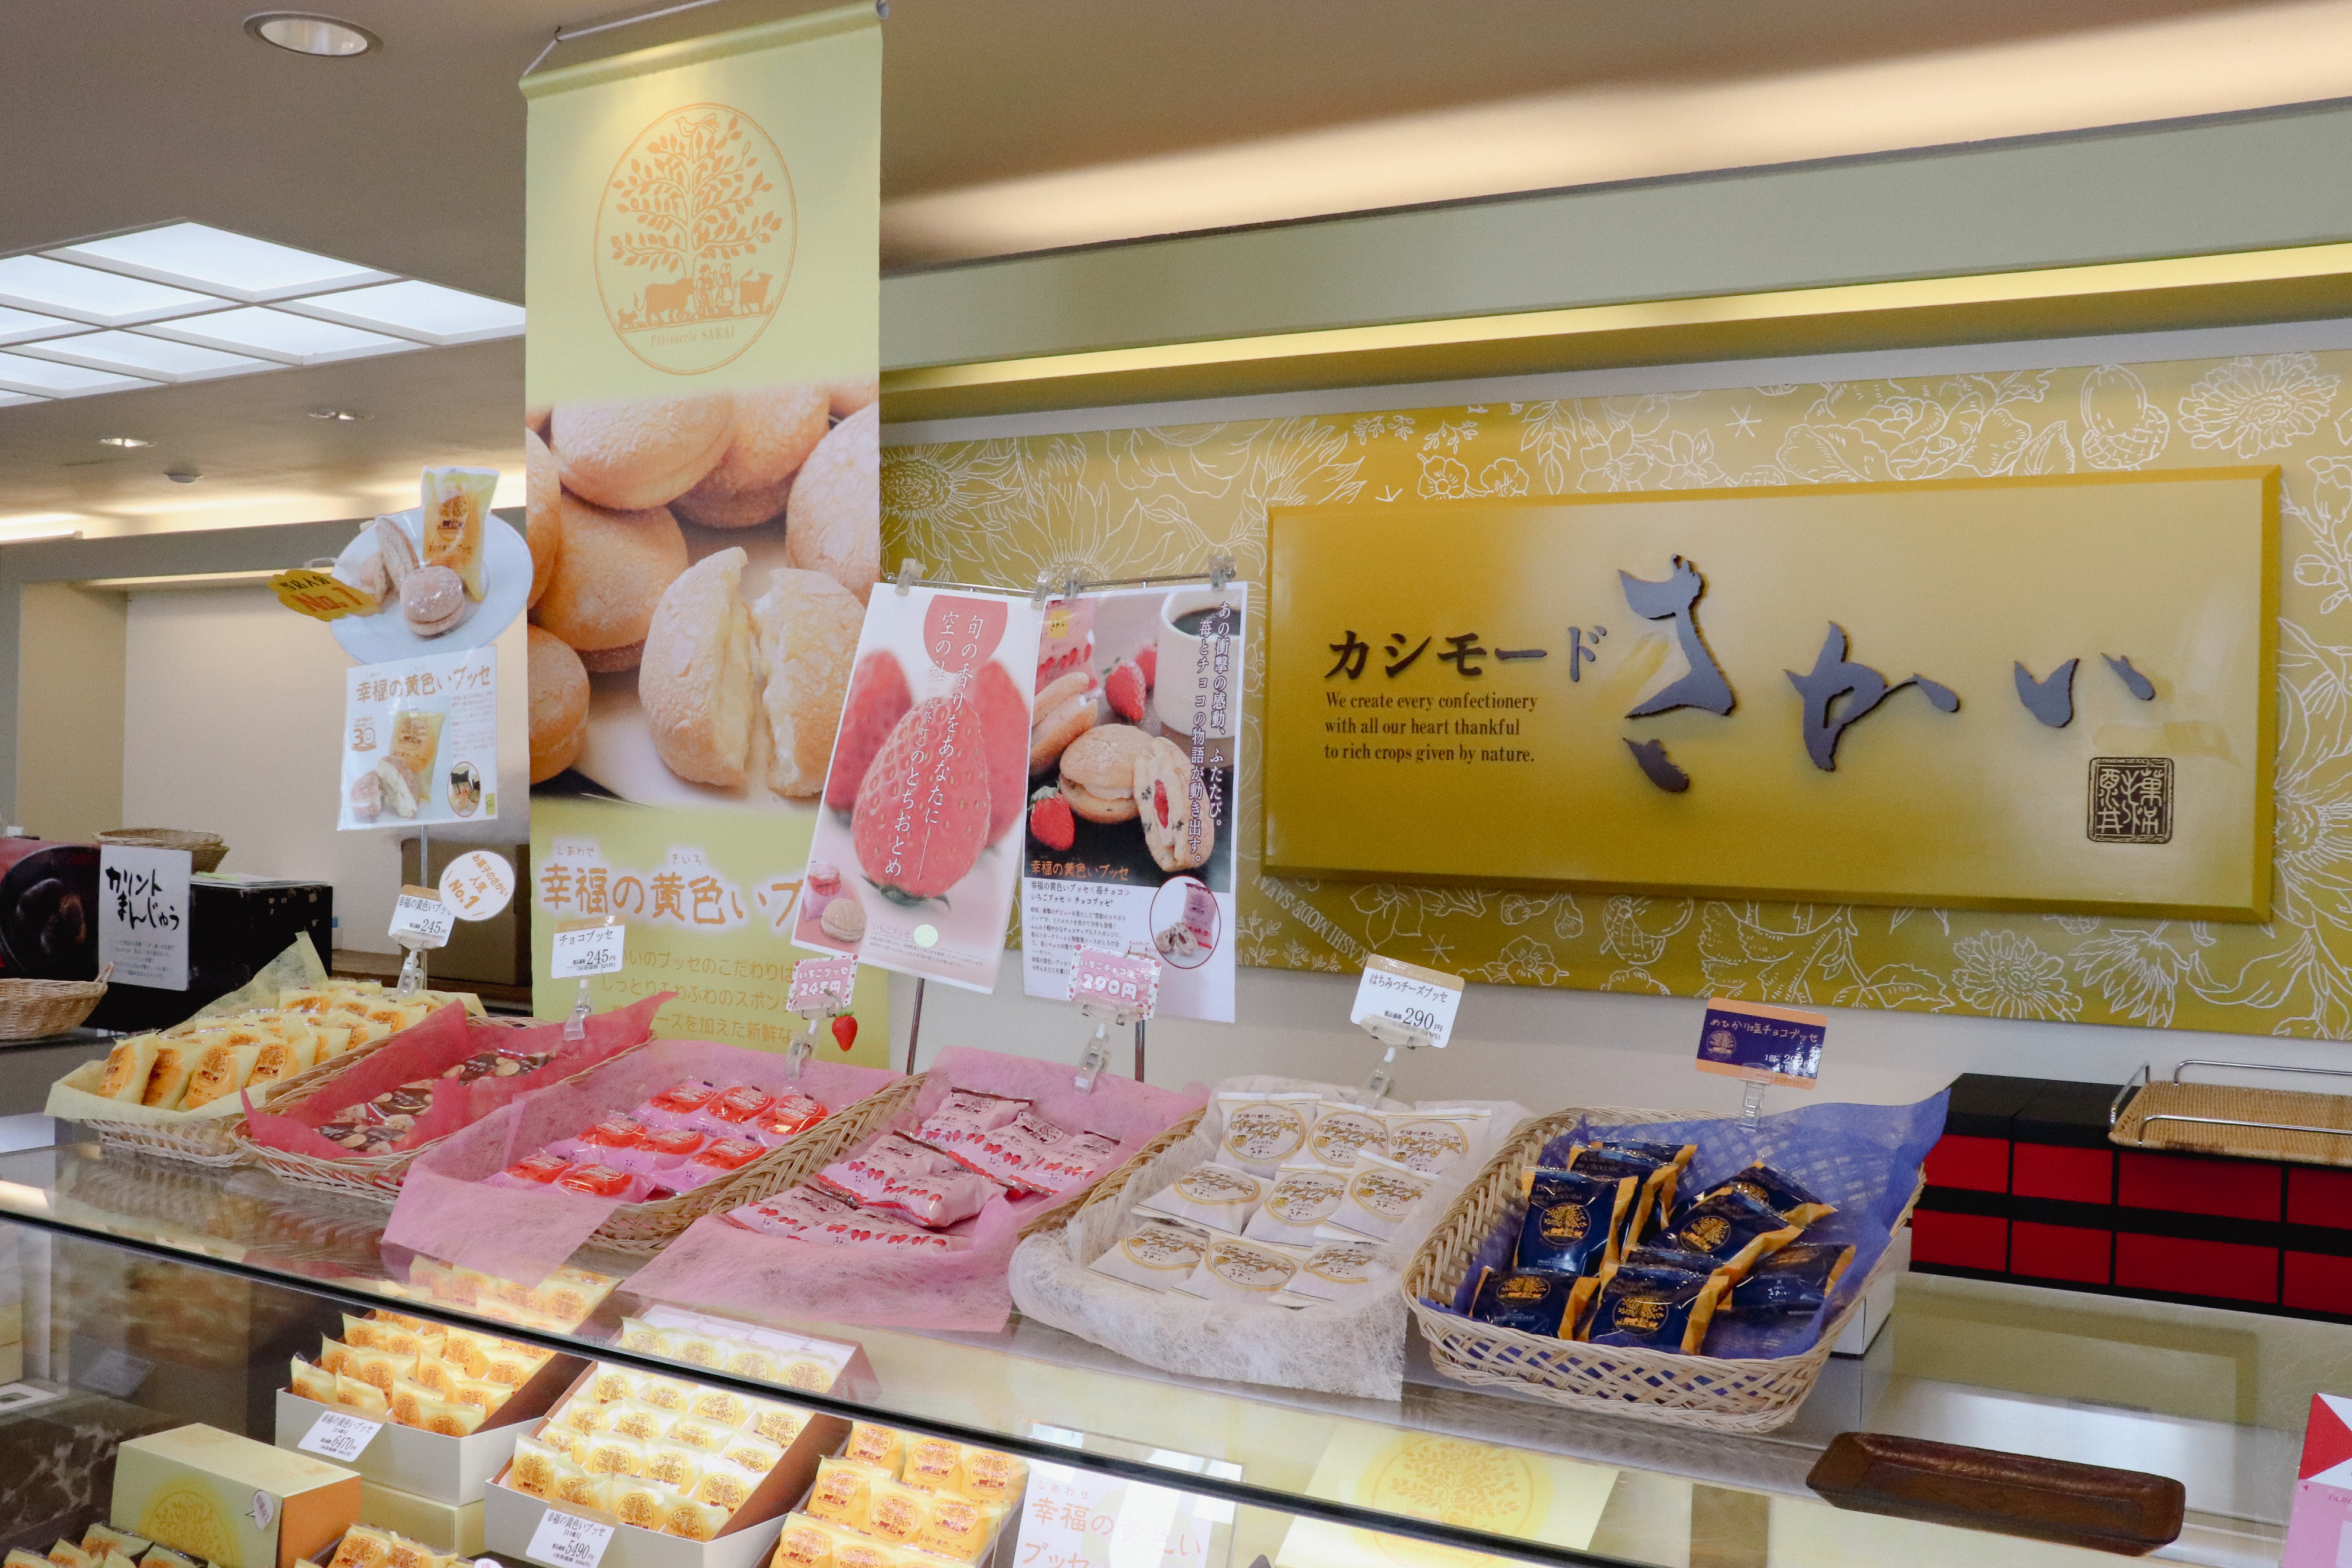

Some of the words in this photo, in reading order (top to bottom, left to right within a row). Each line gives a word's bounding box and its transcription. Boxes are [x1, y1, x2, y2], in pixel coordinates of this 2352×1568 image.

[290, 587, 363, 612] No.1
[1324, 625, 1608, 682] カシモード
[357, 665, 490, 703] 幸福の黄色いブッセ
[1618, 554, 2156, 793] さかい
[1327, 692, 1346, 707] We
[1351, 694, 1393, 708] create
[1397, 696, 1433, 711] every
[1439, 691, 1538, 712] confectionery
[1325, 717, 1355, 733] with
[1361, 718, 1378, 733] all
[1383, 723, 1406, 734] our
[1412, 718, 1448, 734] heart
[1455, 718, 1520, 735] thankful
[1325, 744, 1338, 759] to
[1343, 743, 1370, 759] rich
[1375, 748, 1412, 763] crops
[1416, 744, 1454, 763] given
[1460, 744, 1475, 763] by
[1481, 746, 1534, 762] nature.
[557, 845, 595, 857] しあわせ
[672, 854, 702, 865] きいろ
[1031, 860, 1129, 881] 幸福の黄色いブッセ
[469, 876, 488, 893] 人気
[117, 890, 180, 931] まんじゅう
[560, 929, 613, 946] チョコブッセ
[1081, 973, 1138, 1000] 290円
[1369, 974, 1448, 1002] はちみつチーズブッセ
[1710, 1018, 1818, 1043] めひかり塩チョコブッセ
[1038, 1480, 1090, 1500] しあわせ
[547, 1511, 606, 1537] 幸福の黄色いブッセ
